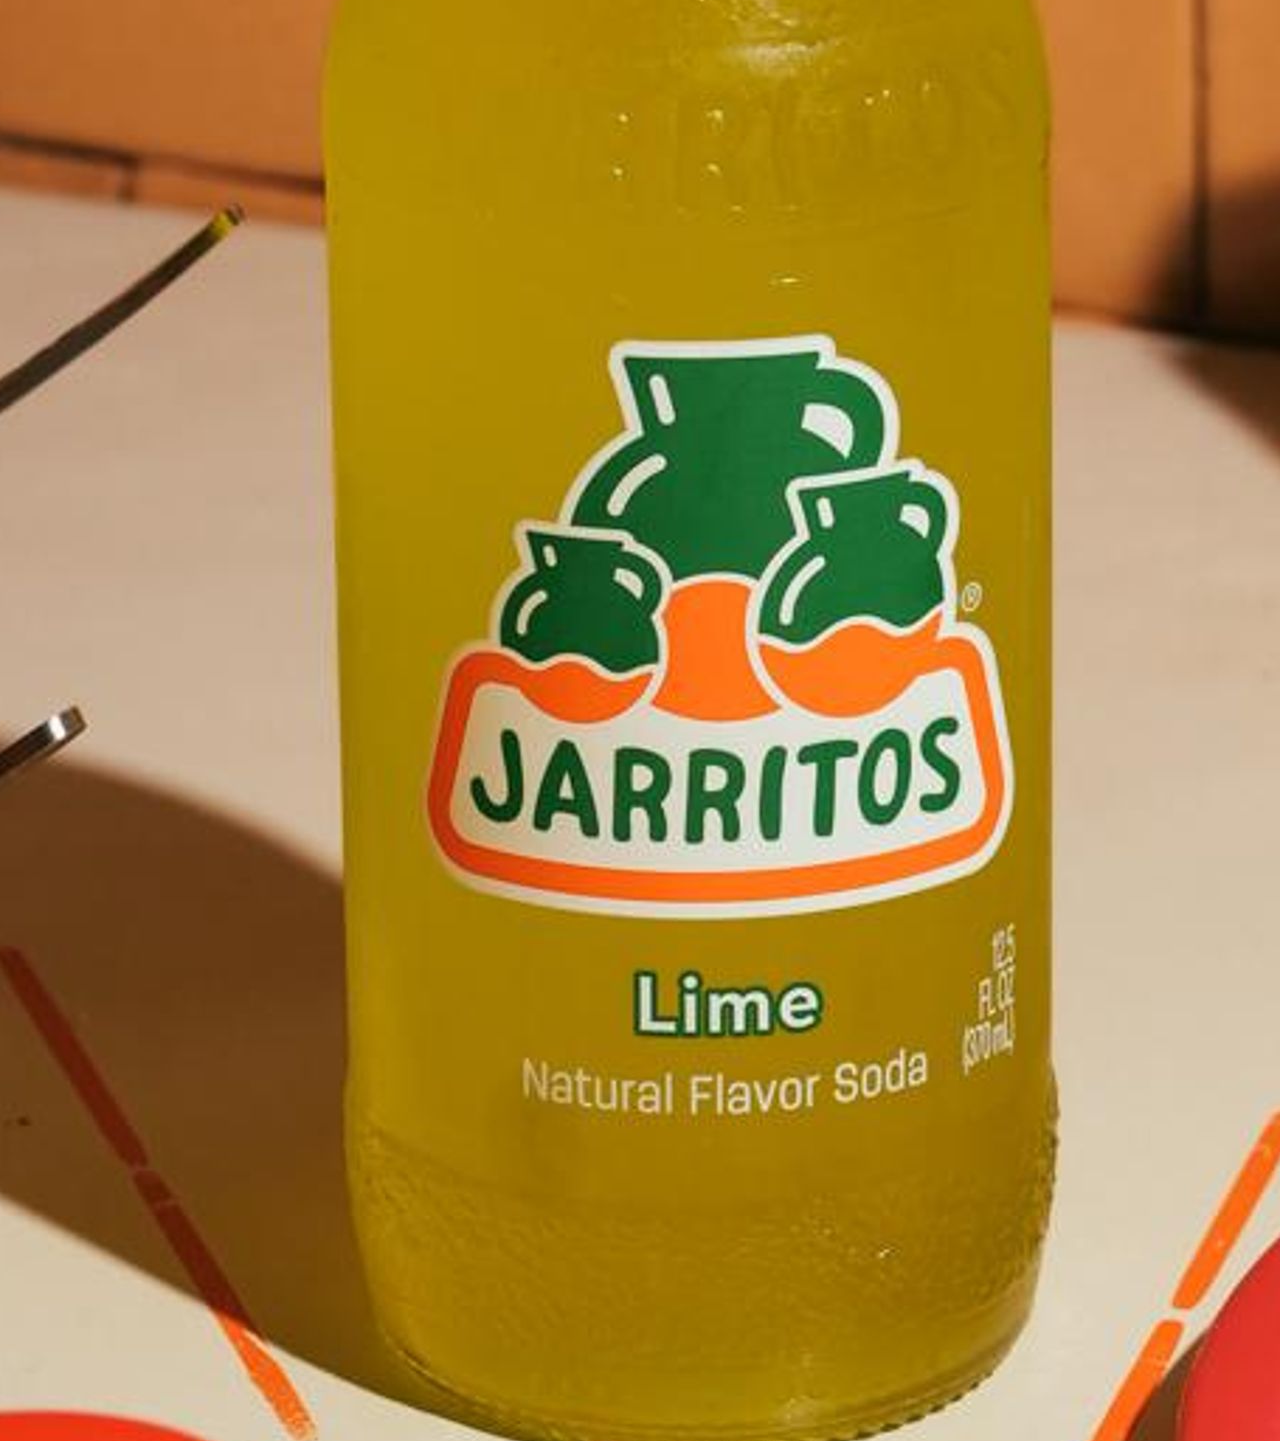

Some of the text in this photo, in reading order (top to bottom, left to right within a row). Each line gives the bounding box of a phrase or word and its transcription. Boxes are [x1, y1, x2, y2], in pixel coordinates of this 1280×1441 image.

[471, 717, 961, 843] JARRITOS
[634, 970, 822, 1037] Lime
[522, 1048, 927, 1115] Natural Flavor Soda
